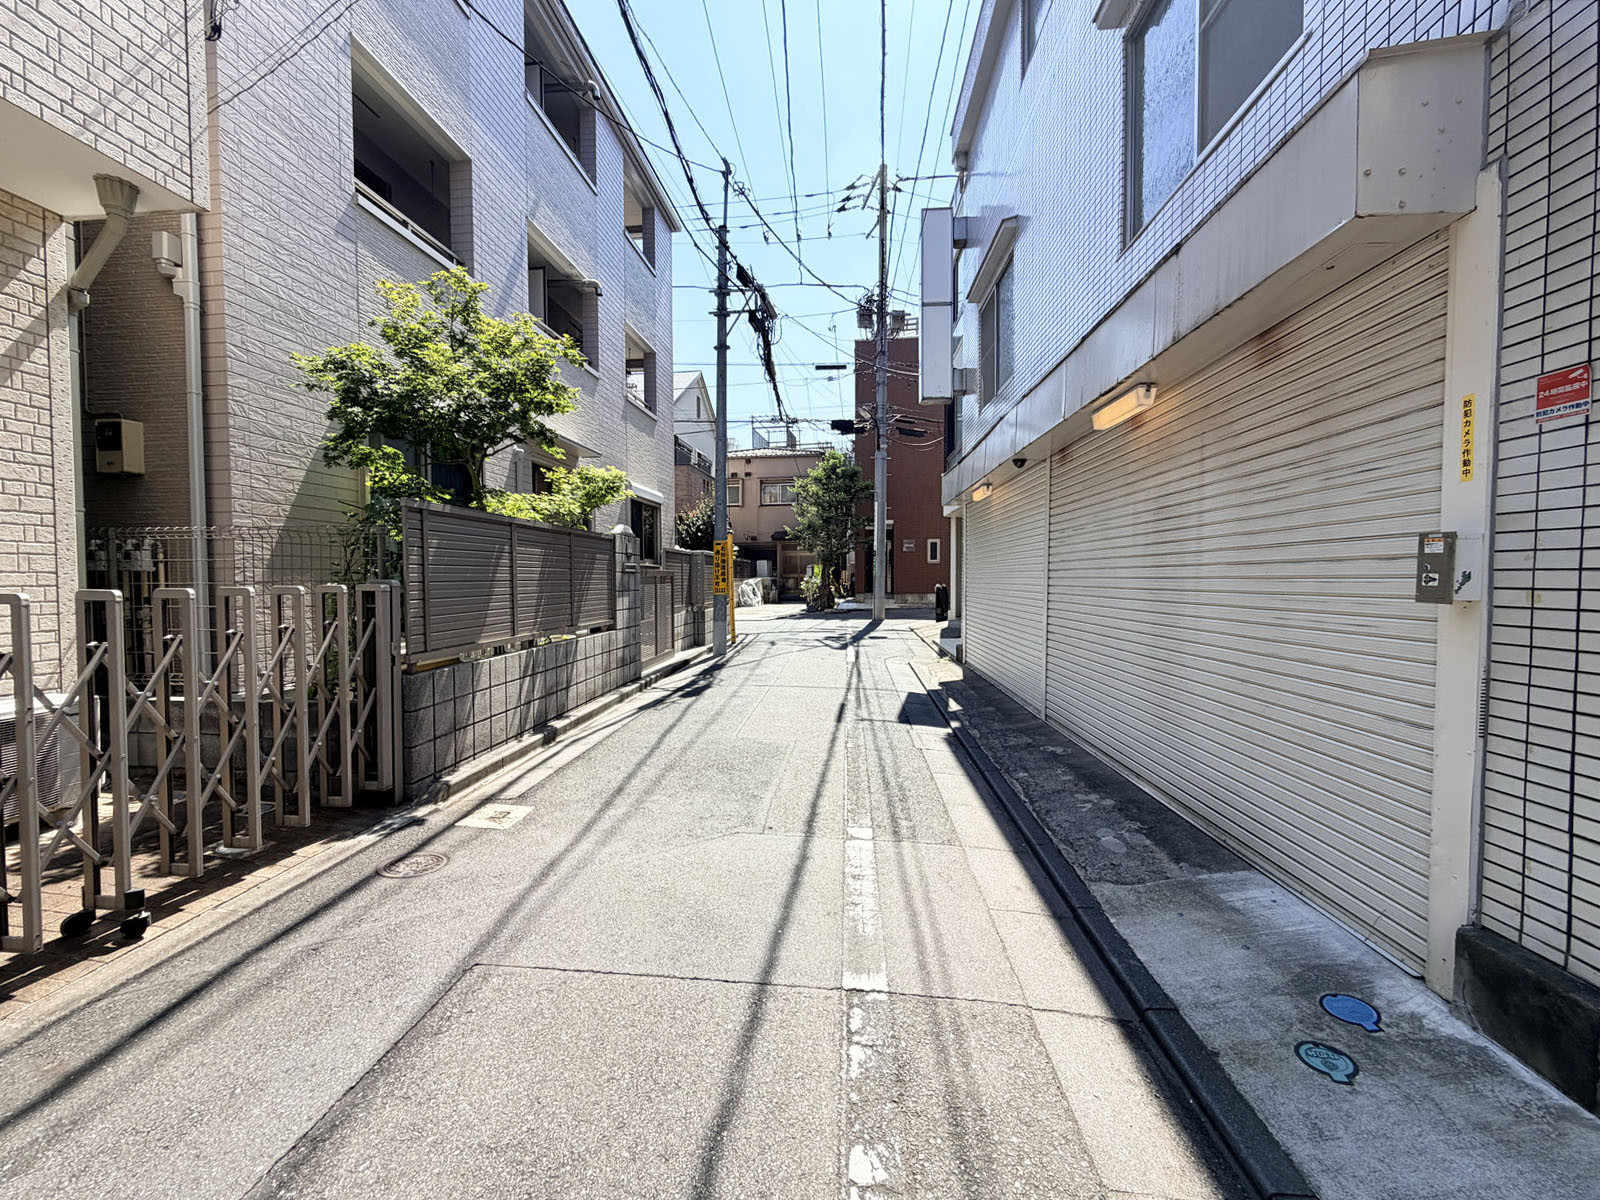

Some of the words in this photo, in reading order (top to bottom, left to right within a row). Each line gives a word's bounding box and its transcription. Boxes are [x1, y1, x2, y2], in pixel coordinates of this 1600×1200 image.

[1535, 400, 1590, 418] 防犯カメラ作動中
[1462, 398, 1473, 477] 防犯カメラ作動中
